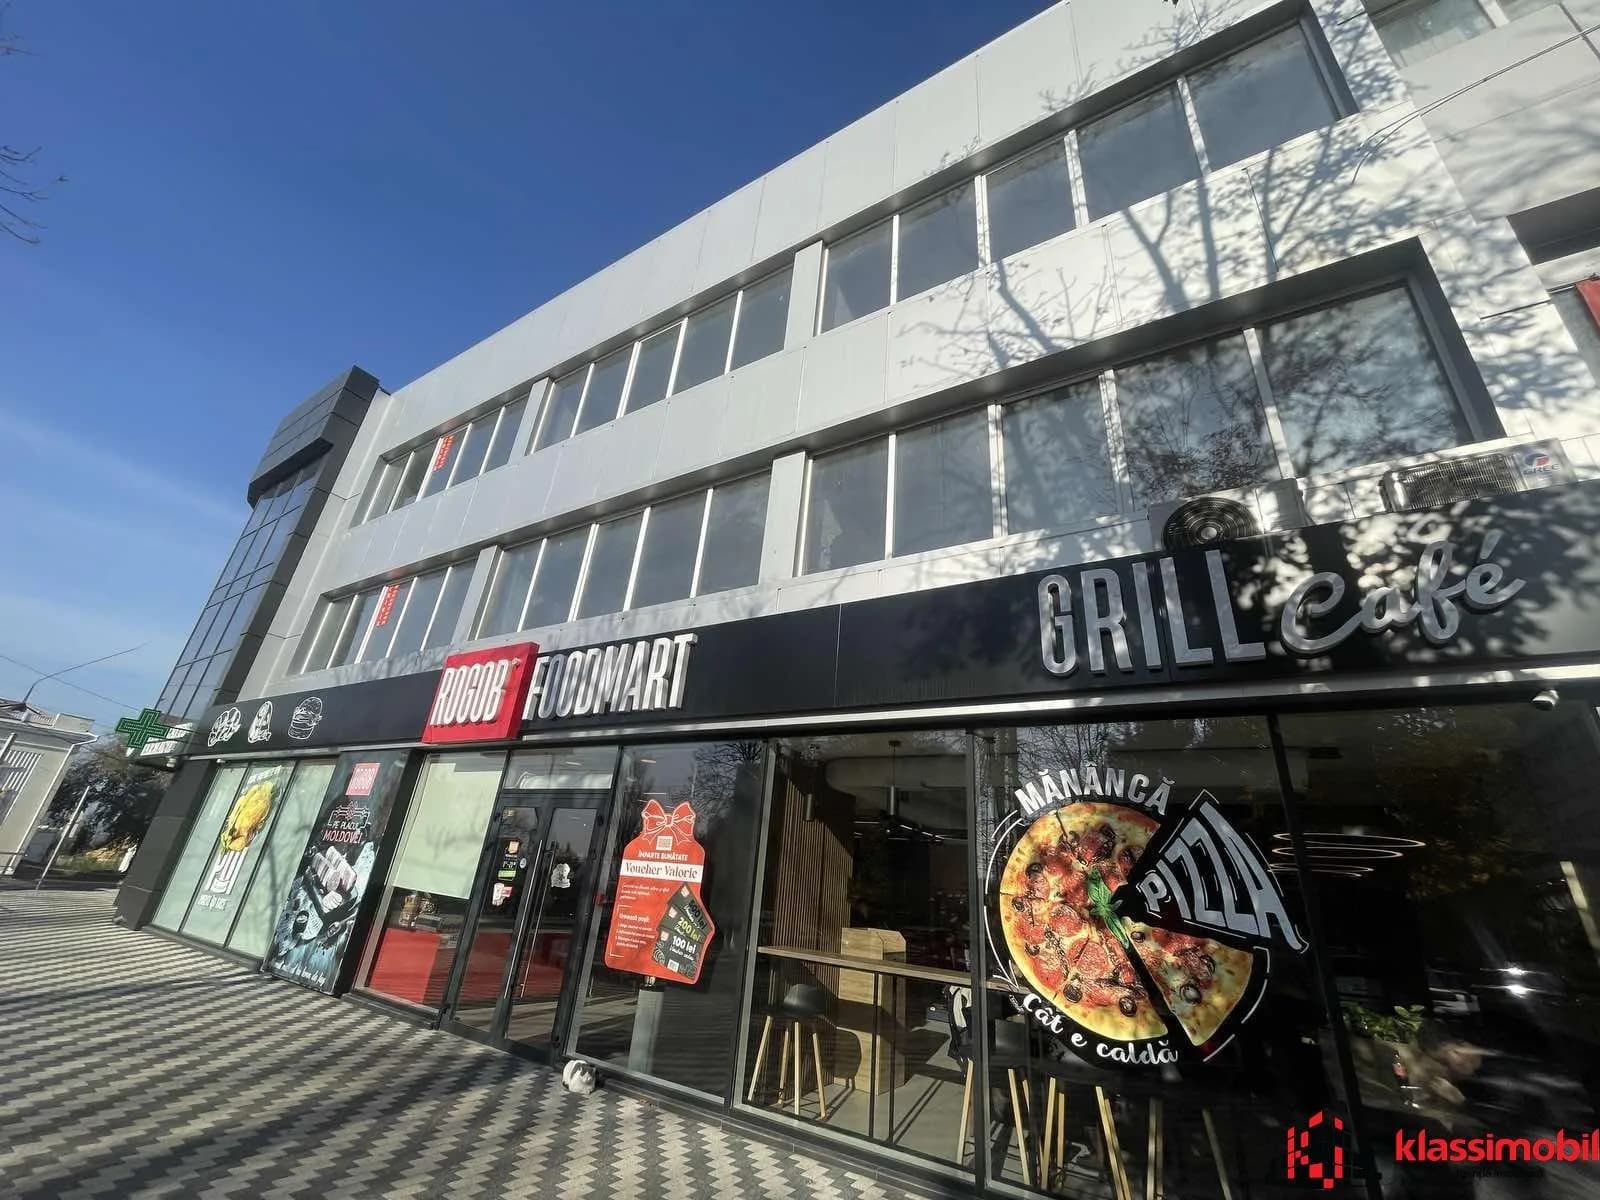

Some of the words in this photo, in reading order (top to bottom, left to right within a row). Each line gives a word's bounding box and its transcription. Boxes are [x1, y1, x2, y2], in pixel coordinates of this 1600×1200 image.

[1037, 549, 1267, 677] GRILL
[1280, 529, 1526, 656] Café
[429, 659, 507, 727] ROGOB
[522, 633, 697, 720] FOODMART
[1014, 763, 1175, 816] MĂNÂNCĂ
[323, 830, 362, 844] MOLDOVEI
[626, 861, 662, 876] Voucher
[665, 864, 698, 879] Valoric
[1139, 801, 1303, 951] PIZZA
[678, 916, 692, 933] 200
[690, 930, 701, 941] lei
[672, 935, 686, 949] 100
[686, 941, 697, 954] lei
[1023, 994, 1067, 1033] Cât
[1071, 1033, 1088, 1048] e
[1096, 1040, 1178, 1065] caldă
